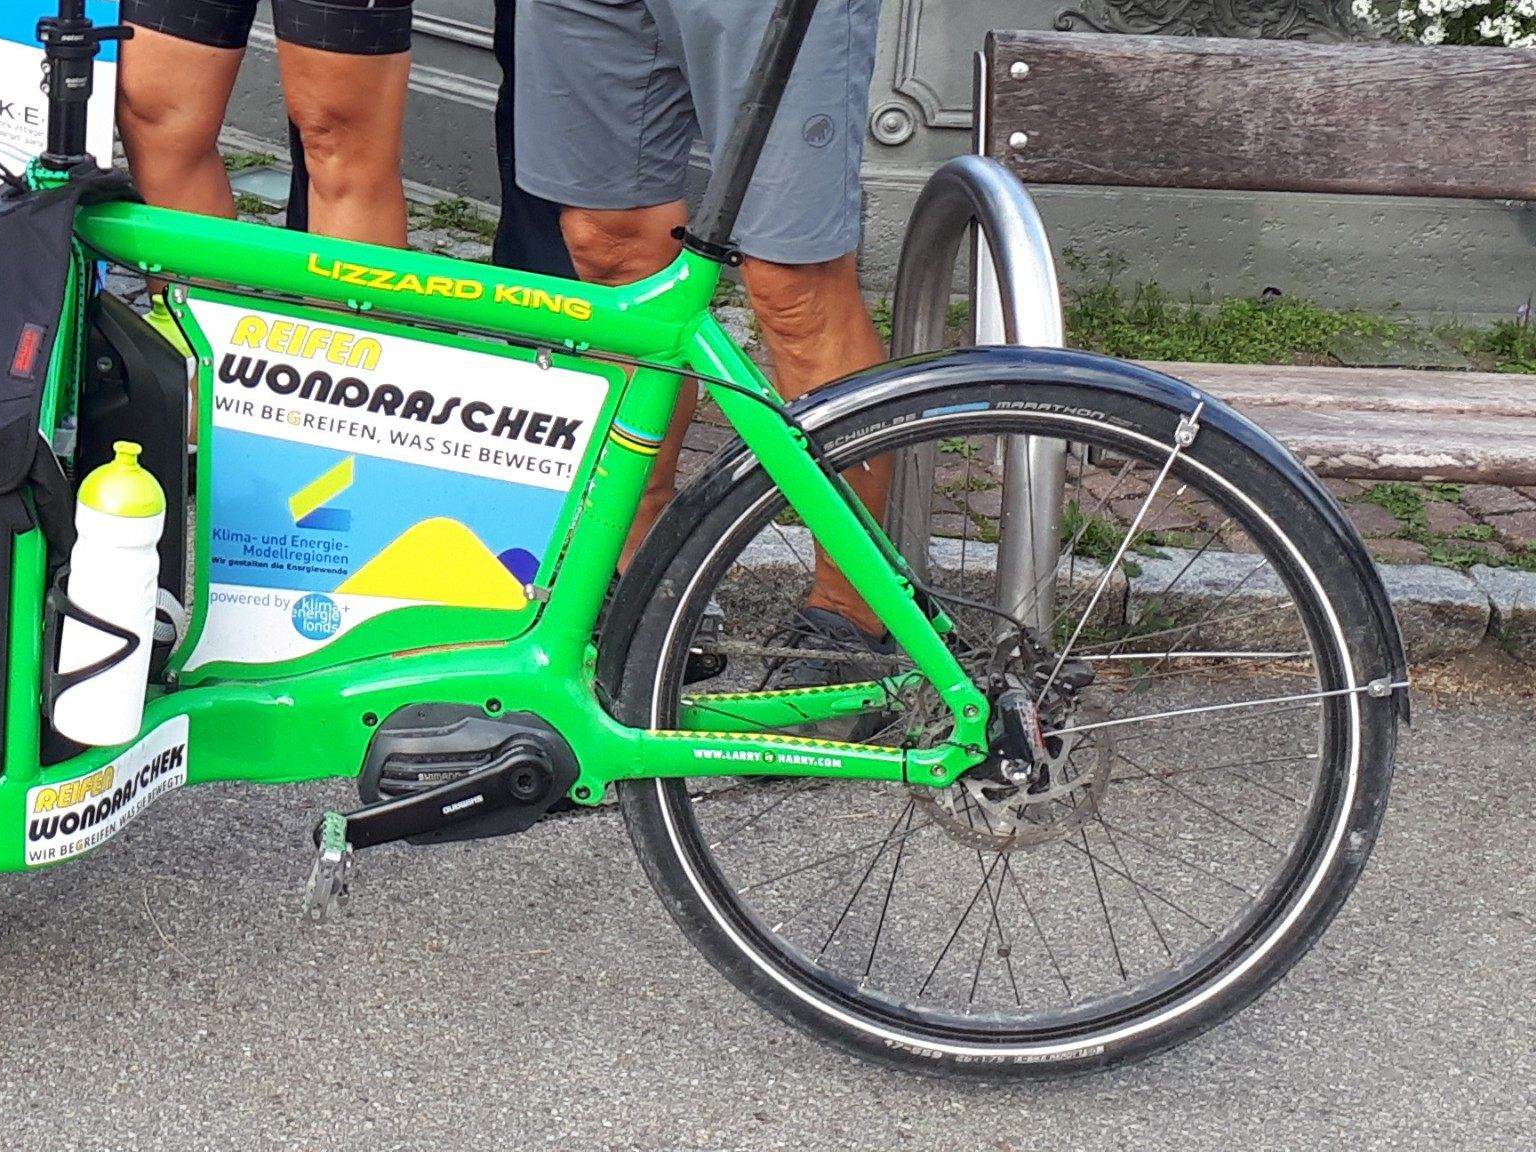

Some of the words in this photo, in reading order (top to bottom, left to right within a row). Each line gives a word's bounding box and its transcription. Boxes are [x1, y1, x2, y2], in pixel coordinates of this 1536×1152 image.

[307, 253, 483, 301] LIZZARD
[494, 285, 592, 321] KING
[229, 314, 383, 372] REIFEN
[217, 352, 585, 451] WONDRASCHEK
[996, 400, 1106, 419] MARATHON
[215, 396, 254, 417] WIR
[261, 404, 382, 443] BEGREIFEN,
[390, 430, 434, 453] WAS
[442, 439, 471, 459] SIE
[478, 447, 573, 479] BEWEGT!
[212, 528, 258, 543] Klima-
[261, 535, 287, 546] und
[291, 535, 349, 552] Energie-
[228, 558, 268, 568] gestalten
[271, 562, 284, 570] die
[286, 563, 348, 575] Energiewende
[243, 545, 349, 564] Modellregionen
[210, 592, 270, 606] powered
[275, 595, 291, 611] by
[28, 743, 186, 842] WONDRASCHEK
[33, 765, 115, 814] REIFEN
[29, 848, 56, 861] WIR
[120, 806, 136, 828] WAS
[148, 774, 184, 804] BEWEGT!
